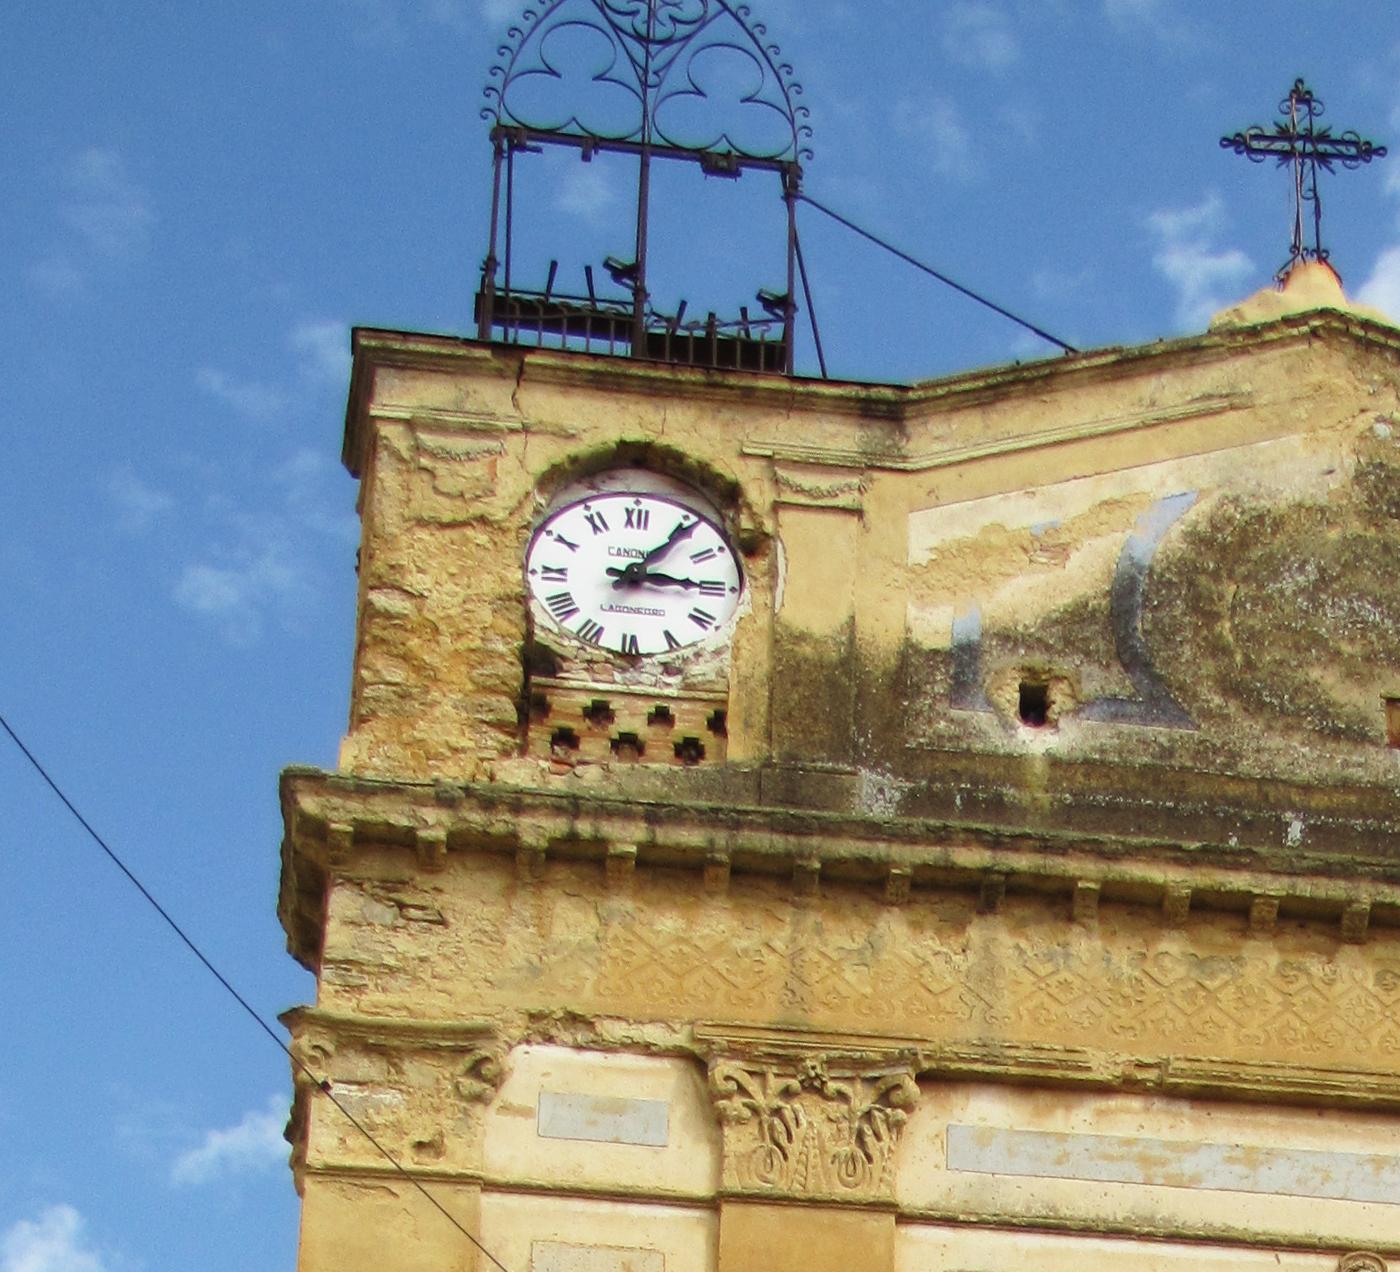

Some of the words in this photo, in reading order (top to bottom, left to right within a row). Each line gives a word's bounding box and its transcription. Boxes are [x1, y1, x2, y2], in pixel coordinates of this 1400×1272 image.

[584, 511, 610, 536] XI
[624, 507, 649, 531] XII
[553, 533, 580, 552] X
[690, 547, 717, 564] II
[541, 565, 568, 582] IX
[699, 580, 726, 597] III
[545, 591, 580, 624] VIII
[687, 607, 716, 631] IV
